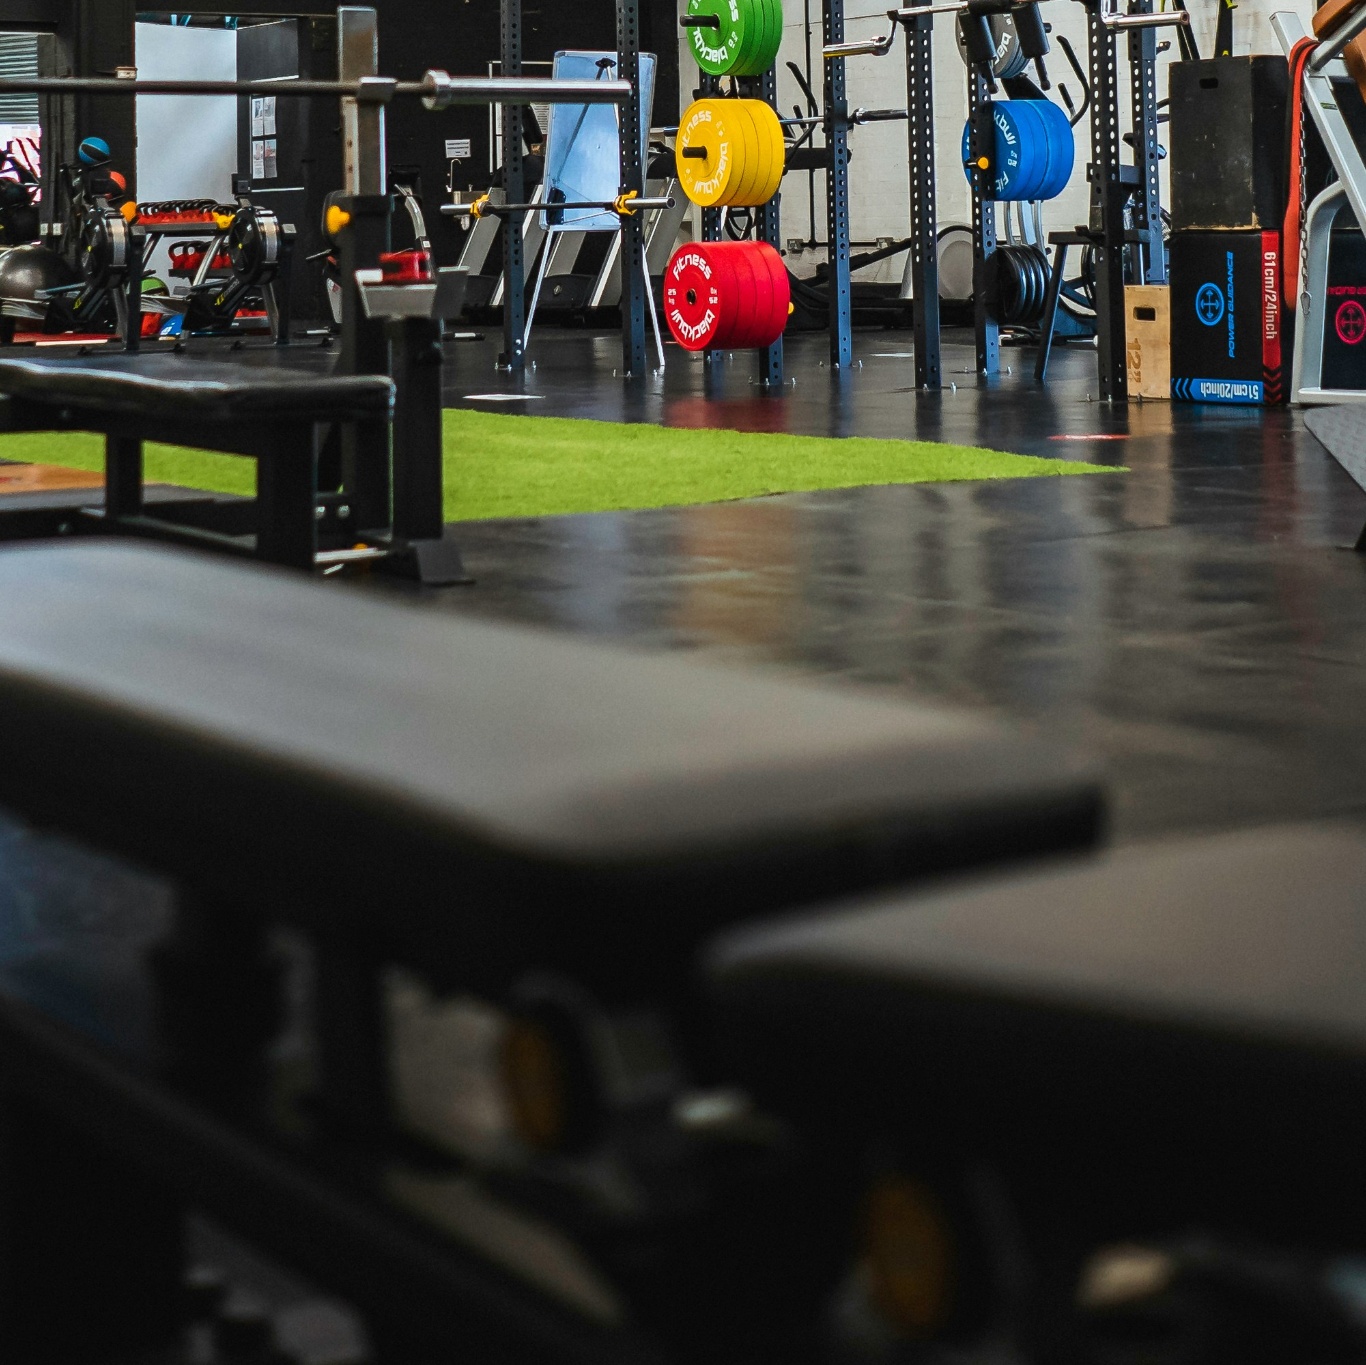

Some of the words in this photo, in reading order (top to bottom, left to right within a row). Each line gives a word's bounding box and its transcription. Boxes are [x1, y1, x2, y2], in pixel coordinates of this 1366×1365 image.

[693, 27, 729, 65] blackb
[681, 110, 712, 148] tness
[693, 142, 729, 195] blackbull
[672, 254, 712, 281] Fitness
[1226, 251, 1235, 314] GUIDANCE
[1263, 251, 1278, 340] 61cm/24inch
[670, 309, 716, 342] blackbull
[1227, 315, 1236, 358] POWER
[1200, 382, 1259, 400] 51cm/20inch
